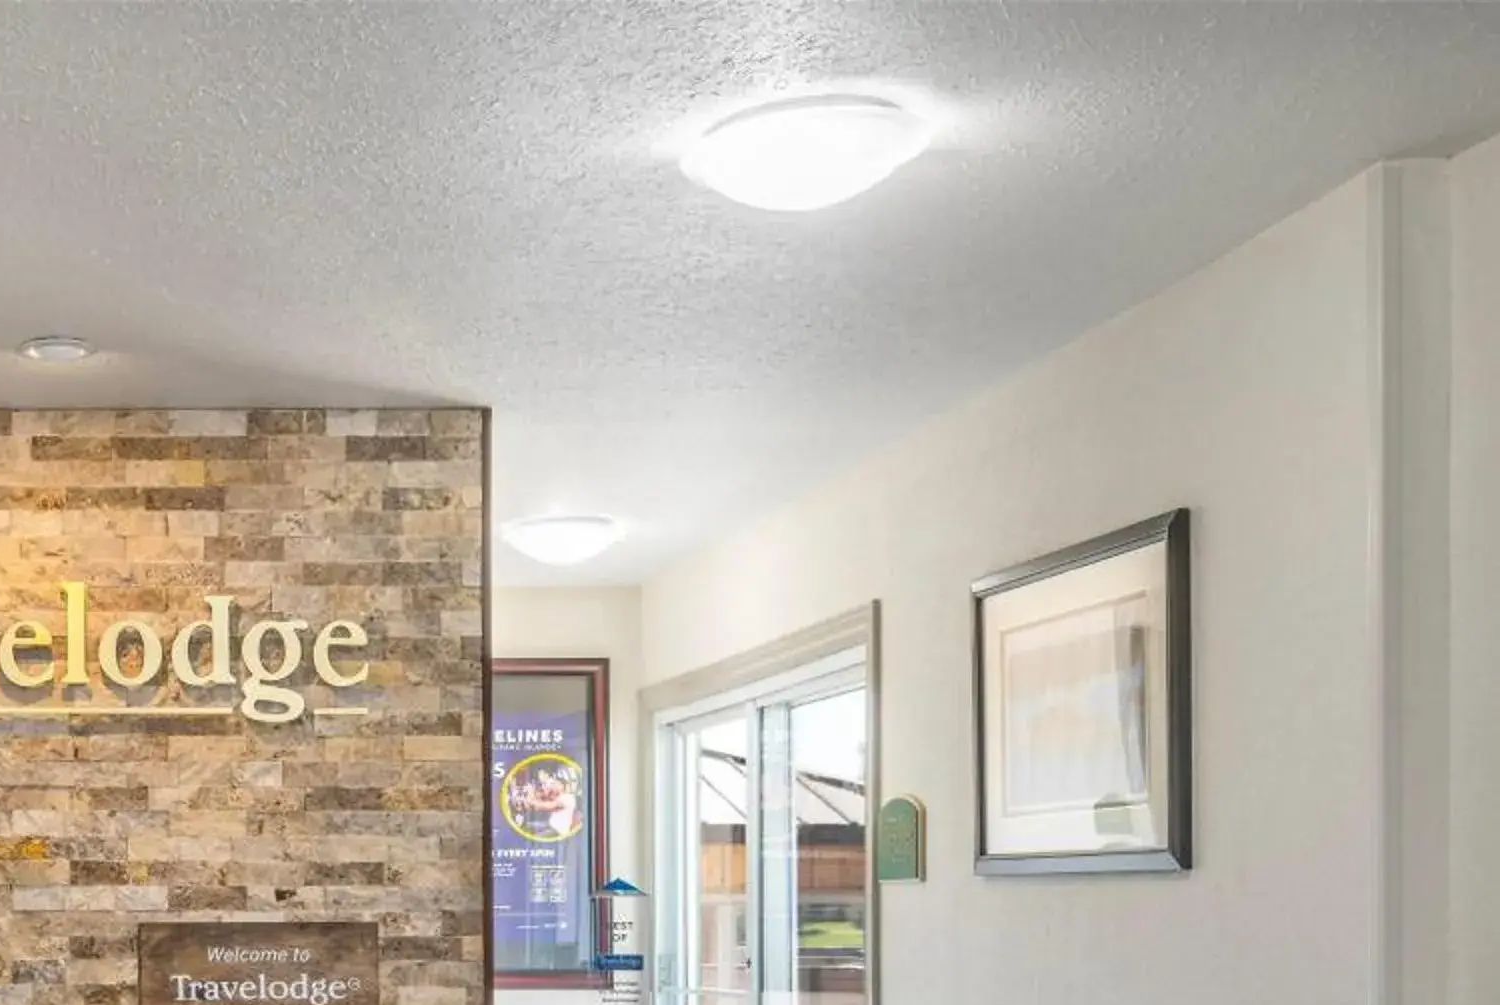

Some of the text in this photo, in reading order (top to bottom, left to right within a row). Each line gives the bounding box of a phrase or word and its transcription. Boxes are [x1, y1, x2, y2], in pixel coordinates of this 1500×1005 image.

[493, 729, 563, 743] ELINES
[207, 946, 311, 963] Welcome to
